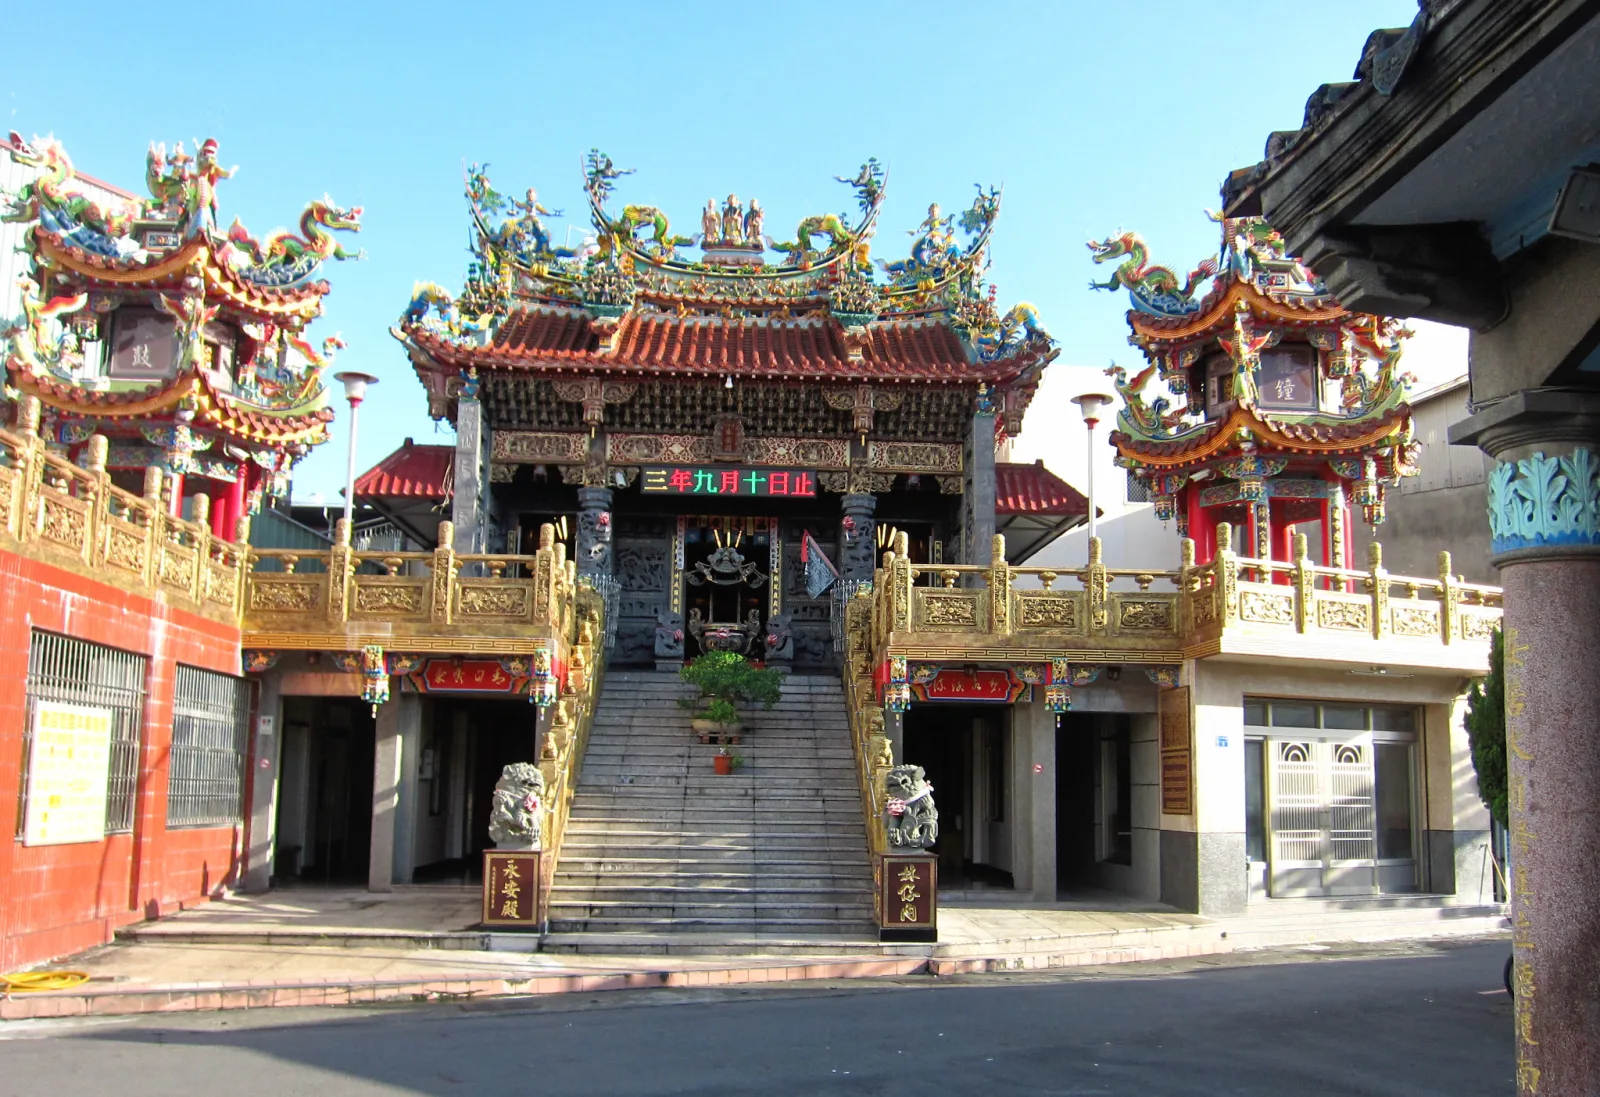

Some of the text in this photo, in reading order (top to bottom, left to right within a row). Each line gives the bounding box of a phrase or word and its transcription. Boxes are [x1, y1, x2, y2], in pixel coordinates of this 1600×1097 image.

[643, 469, 815, 496] 三年九月十日止
[501, 859, 521, 919] 永安殿
